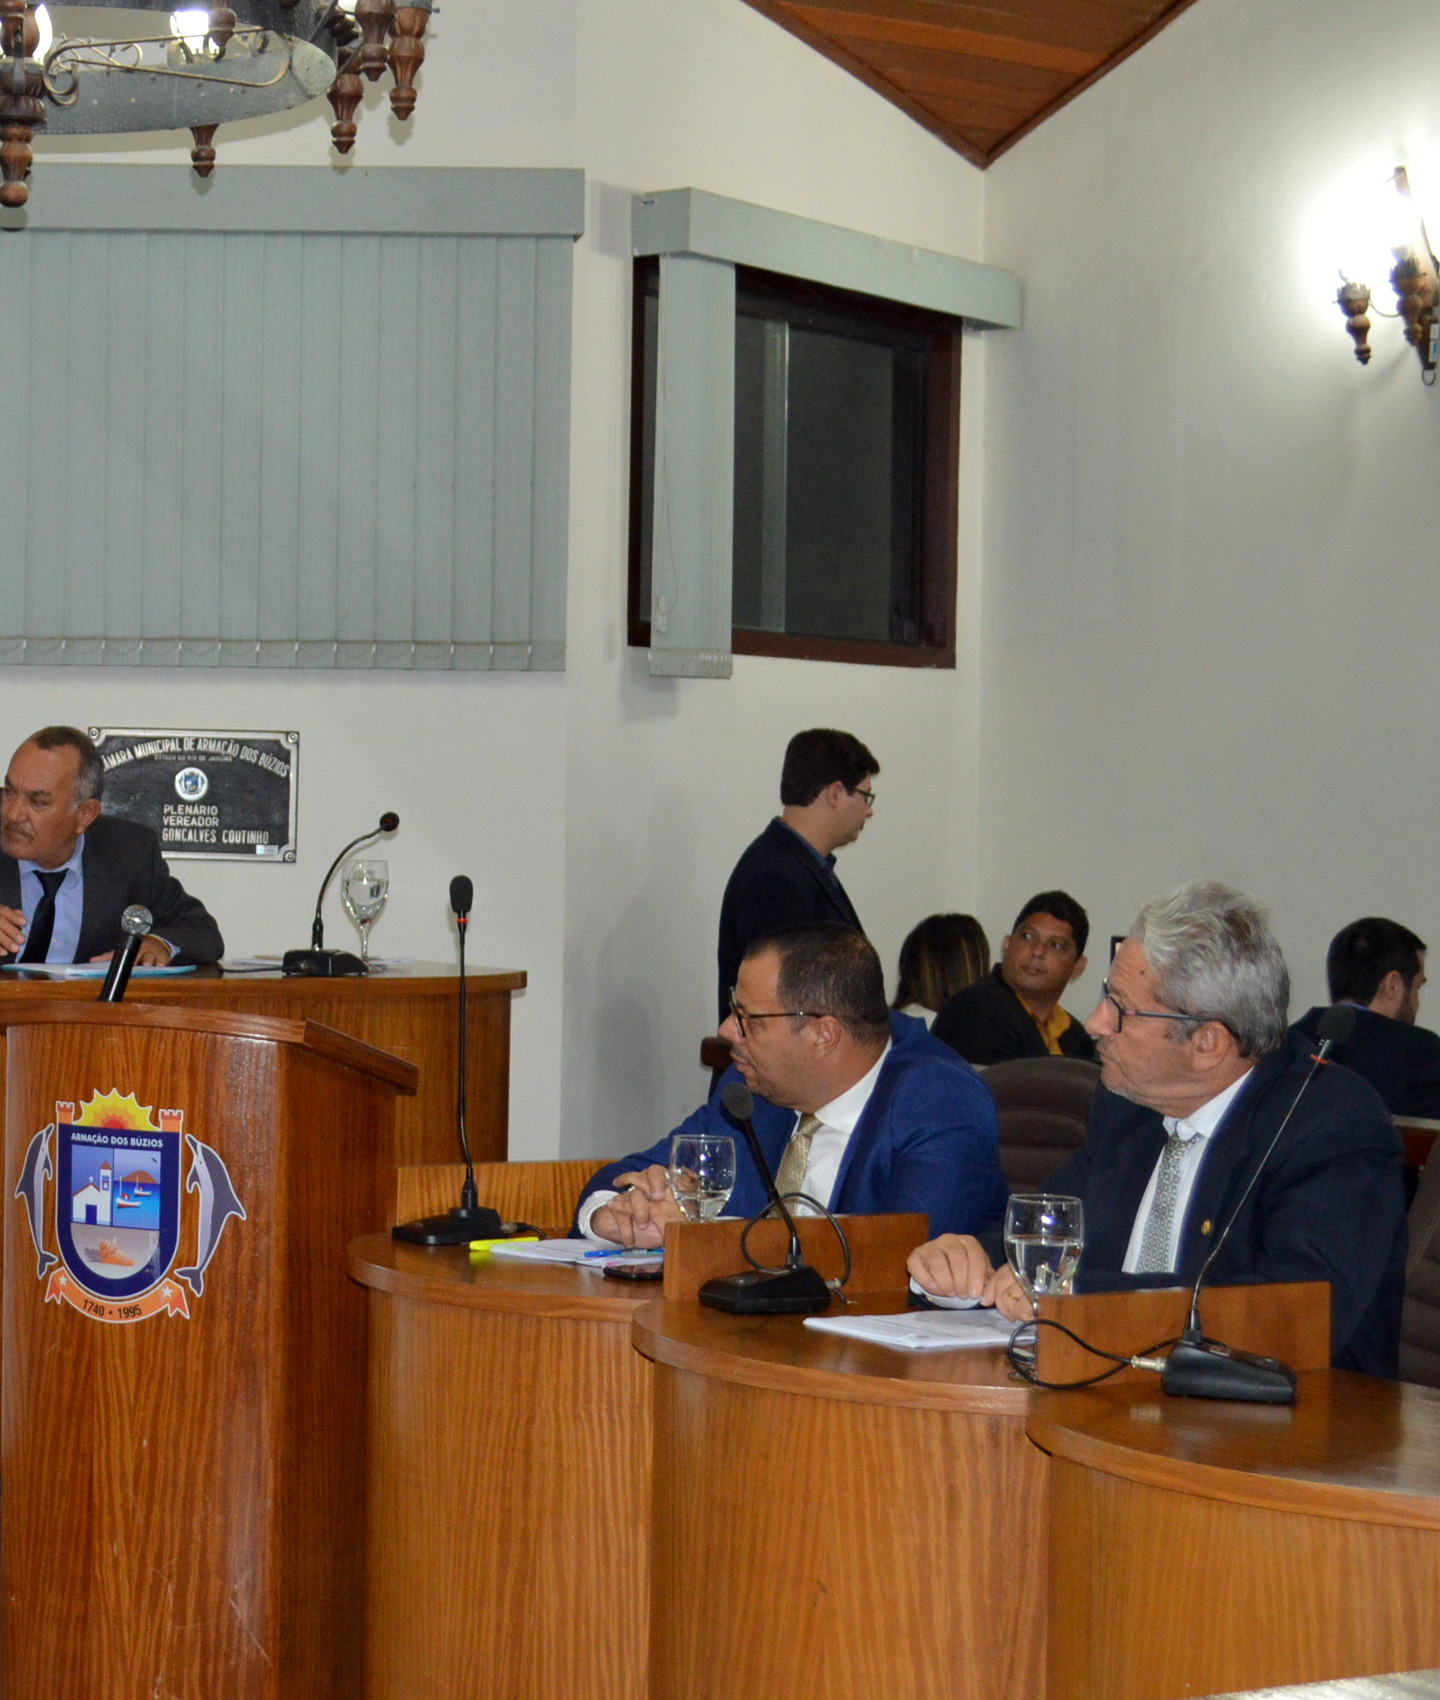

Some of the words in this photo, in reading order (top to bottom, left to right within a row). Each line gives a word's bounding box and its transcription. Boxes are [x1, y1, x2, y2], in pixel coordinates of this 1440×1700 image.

[101, 747, 134, 772] ÂMARA
[133, 738, 182, 760] MUNICIPAL
[183, 737, 196, 751] DE
[196, 738, 240, 758] ARMAÇÃO
[239, 745, 260, 763] DOS
[258, 752, 290, 777] BÚZIOS
[163, 803, 219, 816] PLENÁRIO
[162, 815, 220, 828] VEREADOR
[222, 829, 269, 845] COUTINHO
[71, 1132, 109, 1145] ARMAÇÃO
[110, 1135, 129, 1146] DOS
[130, 1136, 163, 1148] BÚZIOS
[83, 1299, 105, 1317] 1740
[117, 1304, 143, 1319] 1995
